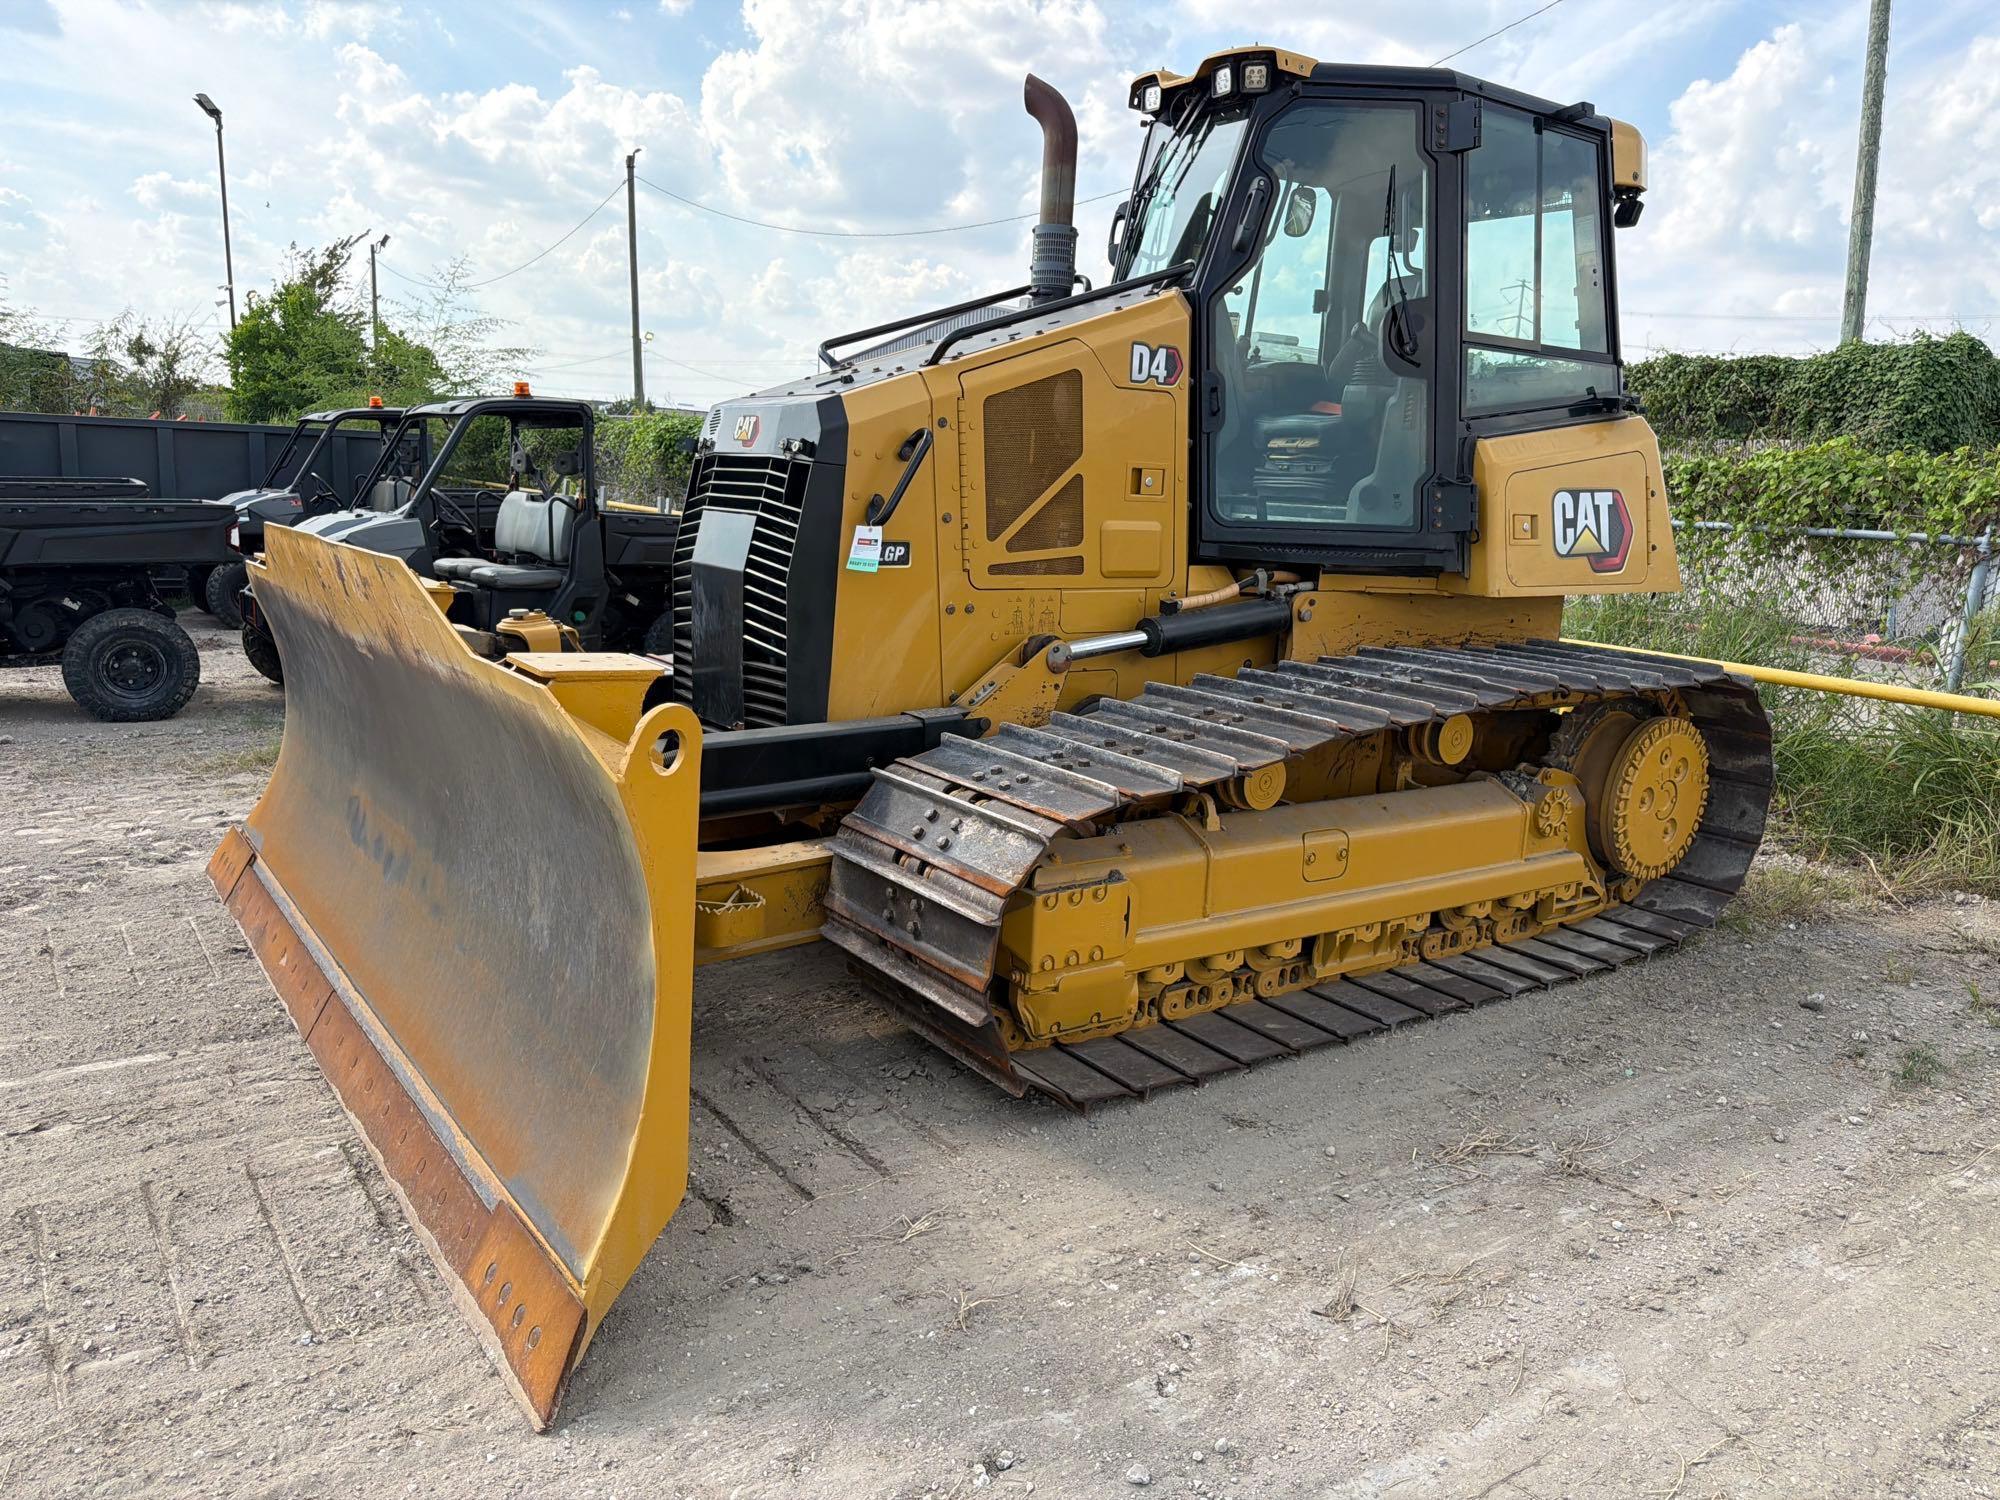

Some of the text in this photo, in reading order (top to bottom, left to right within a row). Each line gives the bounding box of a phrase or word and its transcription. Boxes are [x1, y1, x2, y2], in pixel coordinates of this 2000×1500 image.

[1131, 343, 1168, 383] D4
[734, 416, 757, 440] CAT
[1553, 491, 1613, 555] CAT
